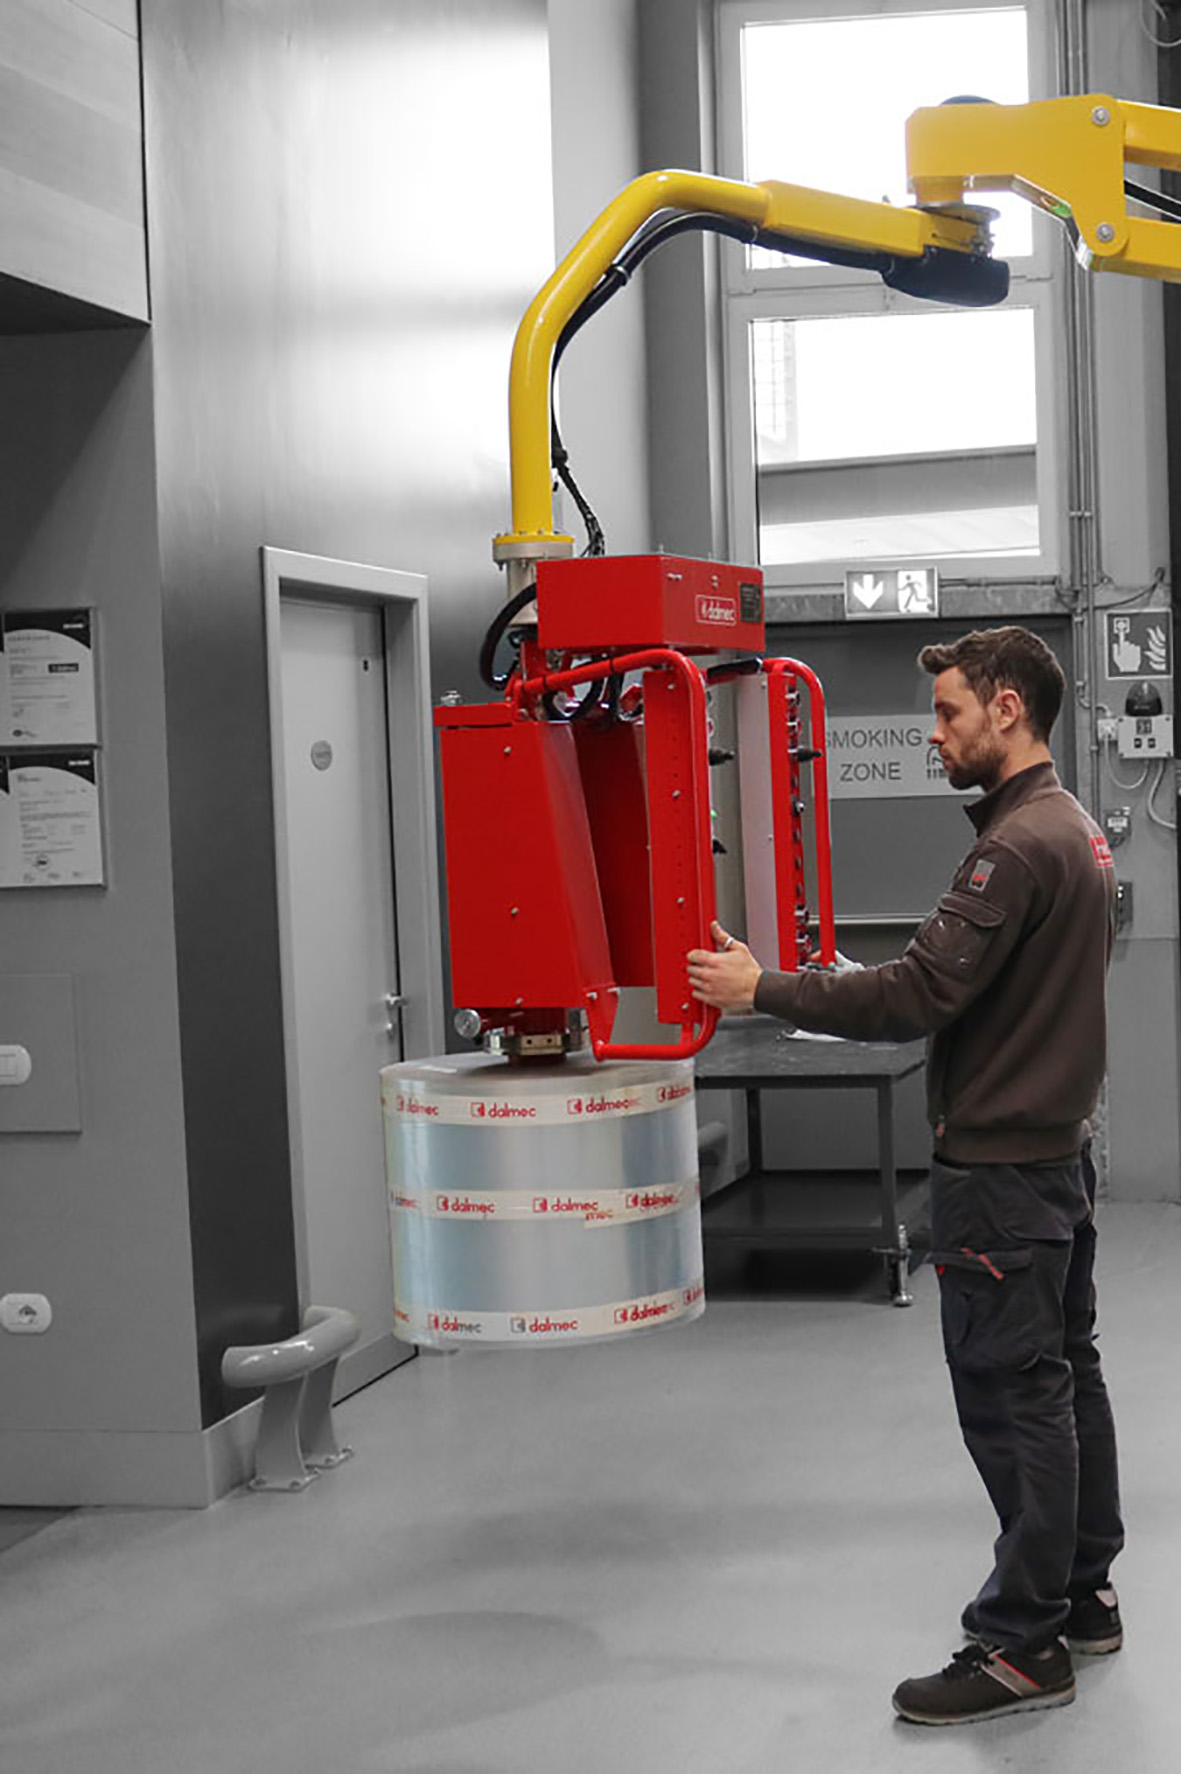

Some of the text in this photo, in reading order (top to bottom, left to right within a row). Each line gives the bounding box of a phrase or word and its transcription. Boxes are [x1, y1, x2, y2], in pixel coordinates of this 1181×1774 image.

[840, 761, 902, 782] ZONE
[488, 1102, 536, 1118] dalmec
[451, 1197, 495, 1214] dalmec
[551, 1197, 599, 1212] dalmec
[441, 1314, 482, 1334] dalmec
[529, 1317, 578, 1333] dalmec
